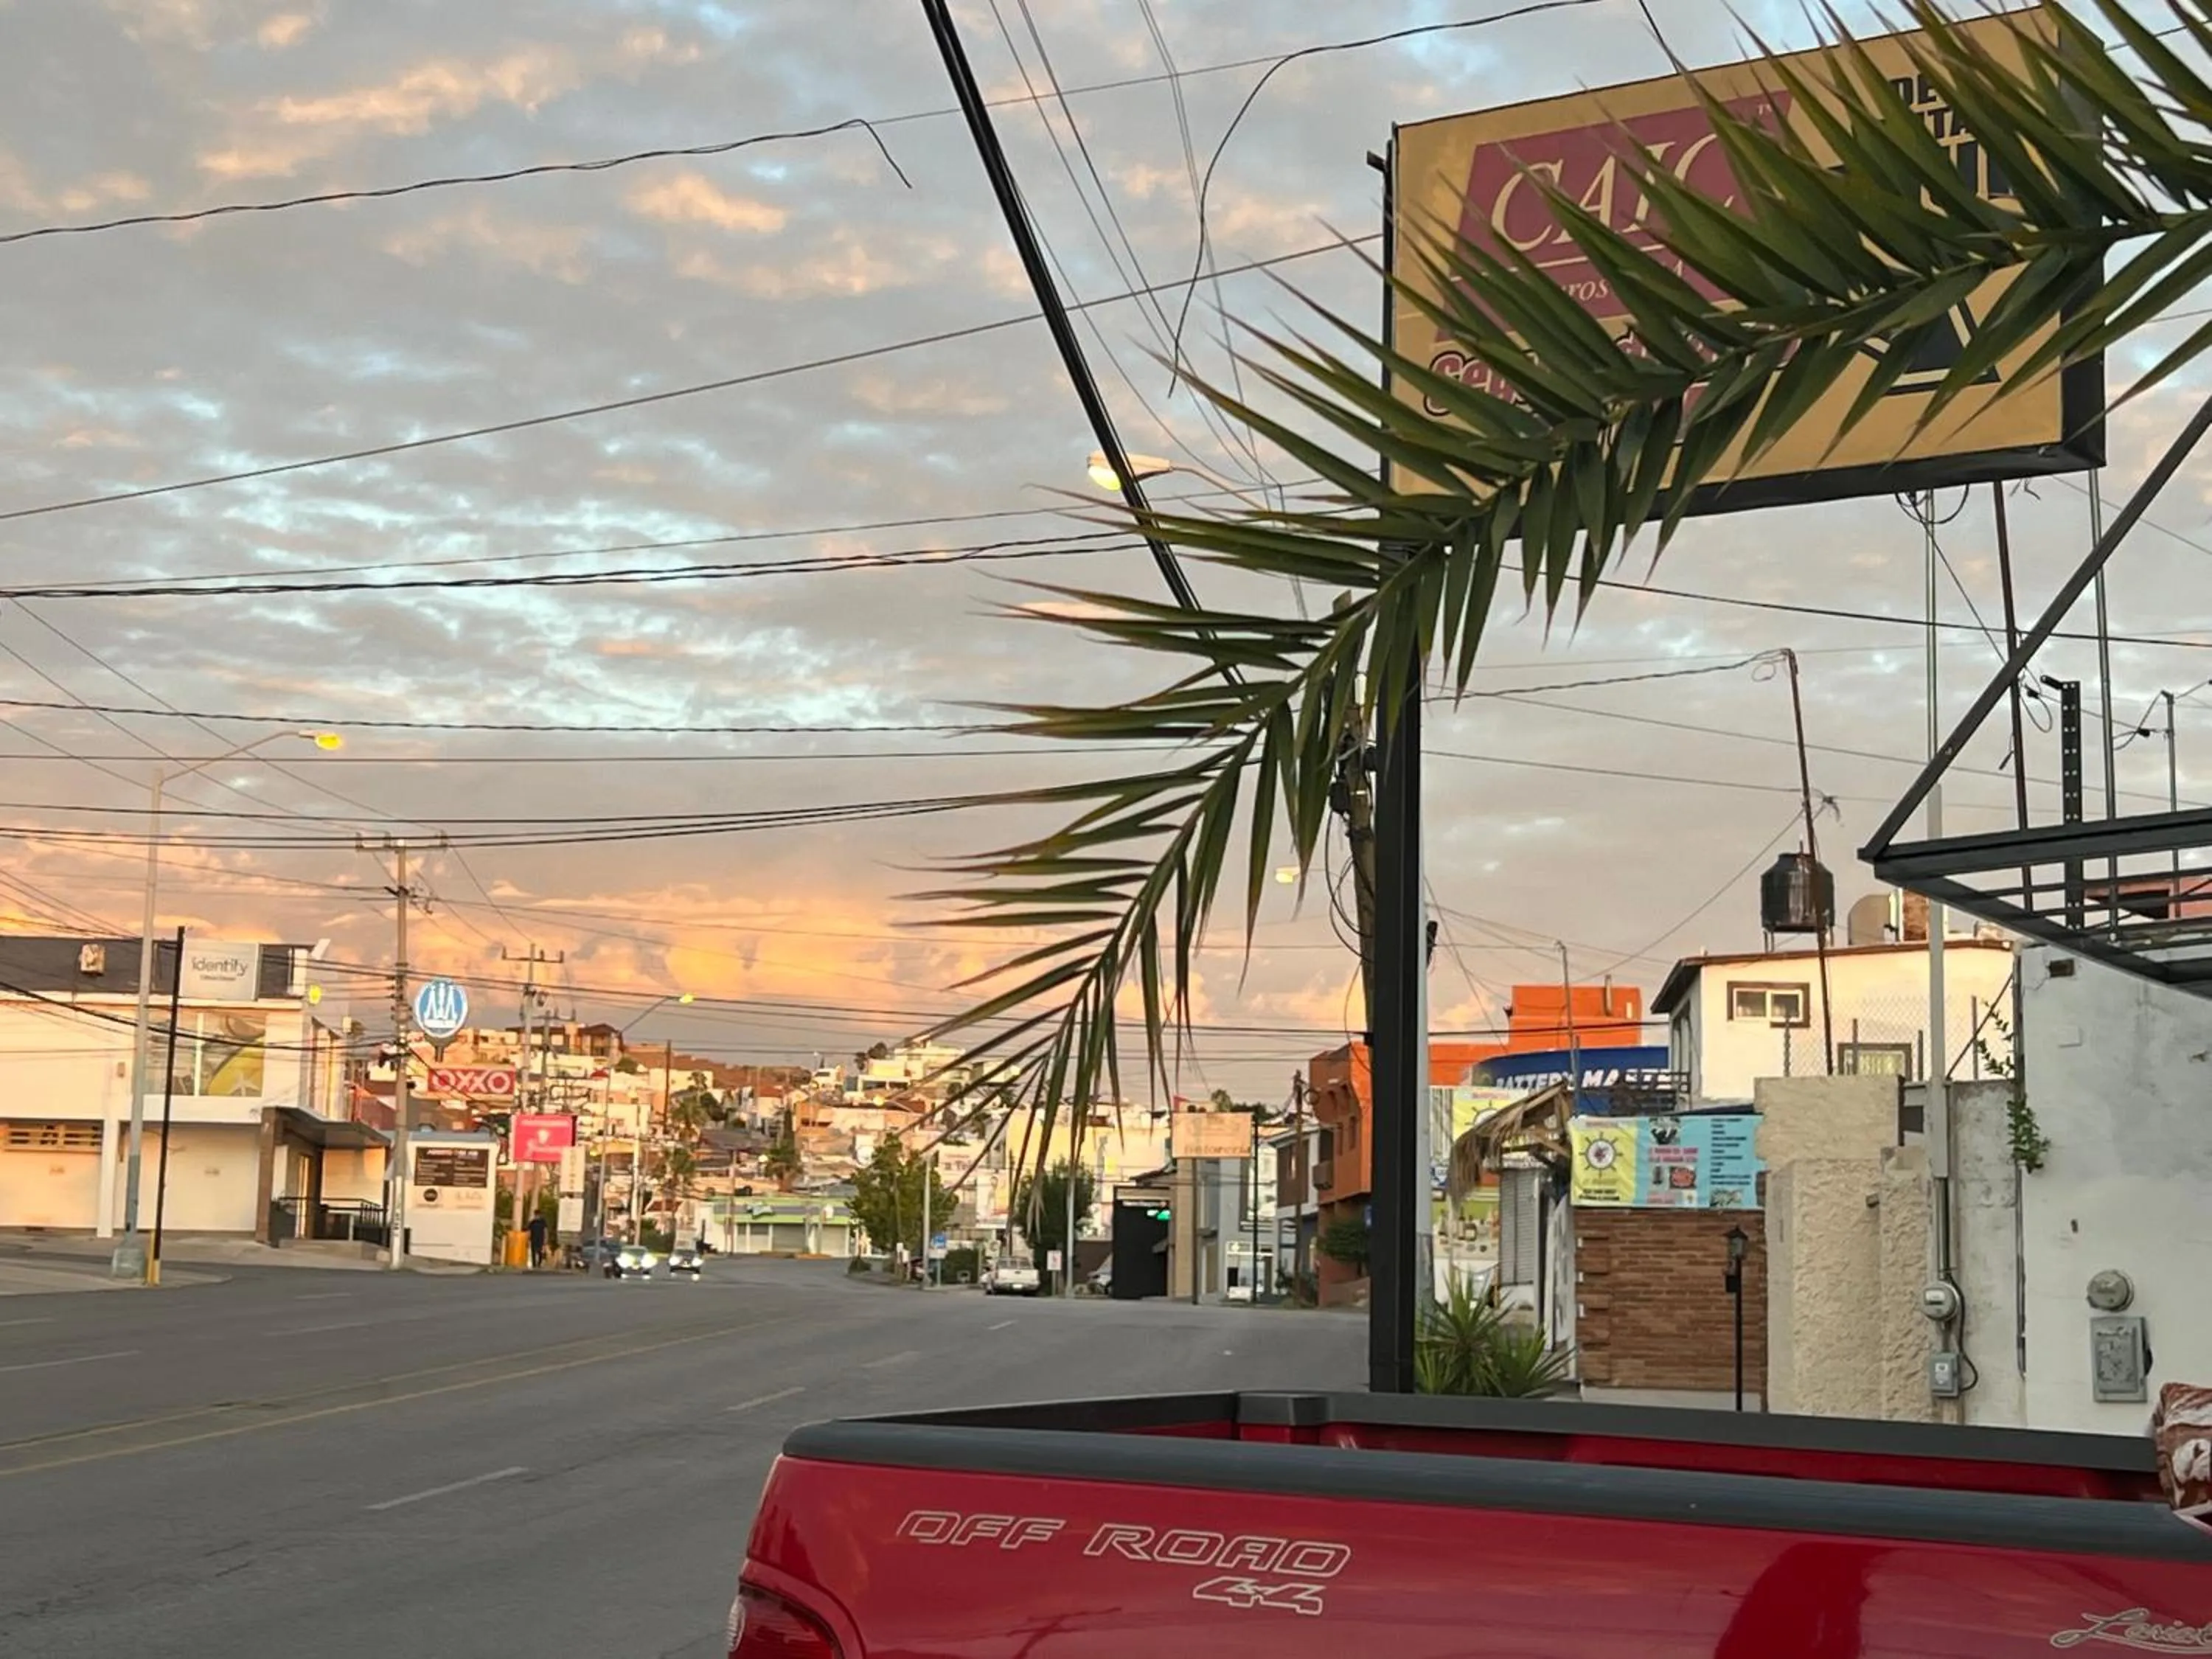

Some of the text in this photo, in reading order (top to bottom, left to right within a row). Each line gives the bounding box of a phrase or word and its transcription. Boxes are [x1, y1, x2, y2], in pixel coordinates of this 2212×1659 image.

[431, 1069, 510, 1093] OXXO
[896, 1510, 1352, 1578] OFF ROAD
